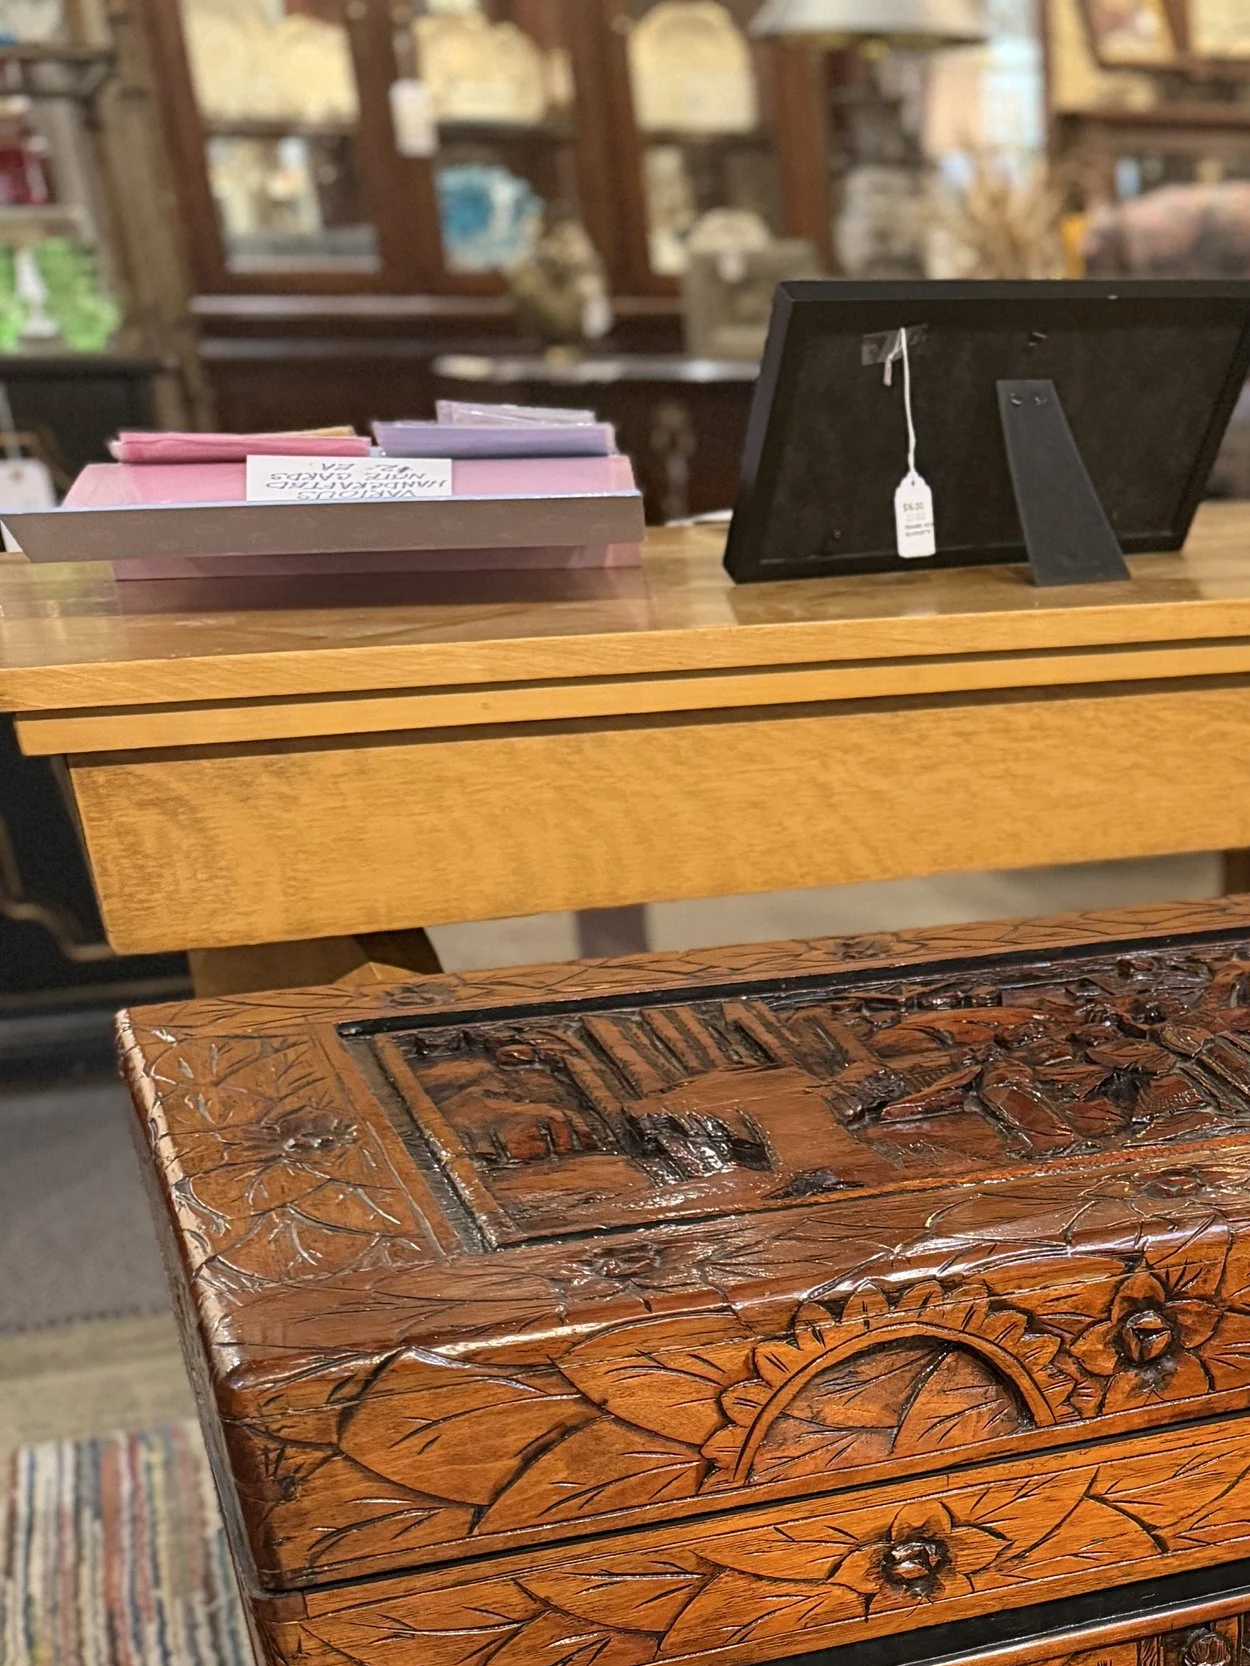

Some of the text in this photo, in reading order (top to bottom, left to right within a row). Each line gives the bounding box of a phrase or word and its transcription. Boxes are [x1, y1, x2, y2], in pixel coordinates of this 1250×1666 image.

[270, 472, 426, 481] NOTE CARDS
[266, 479, 448, 490] HANDCRAFTED
